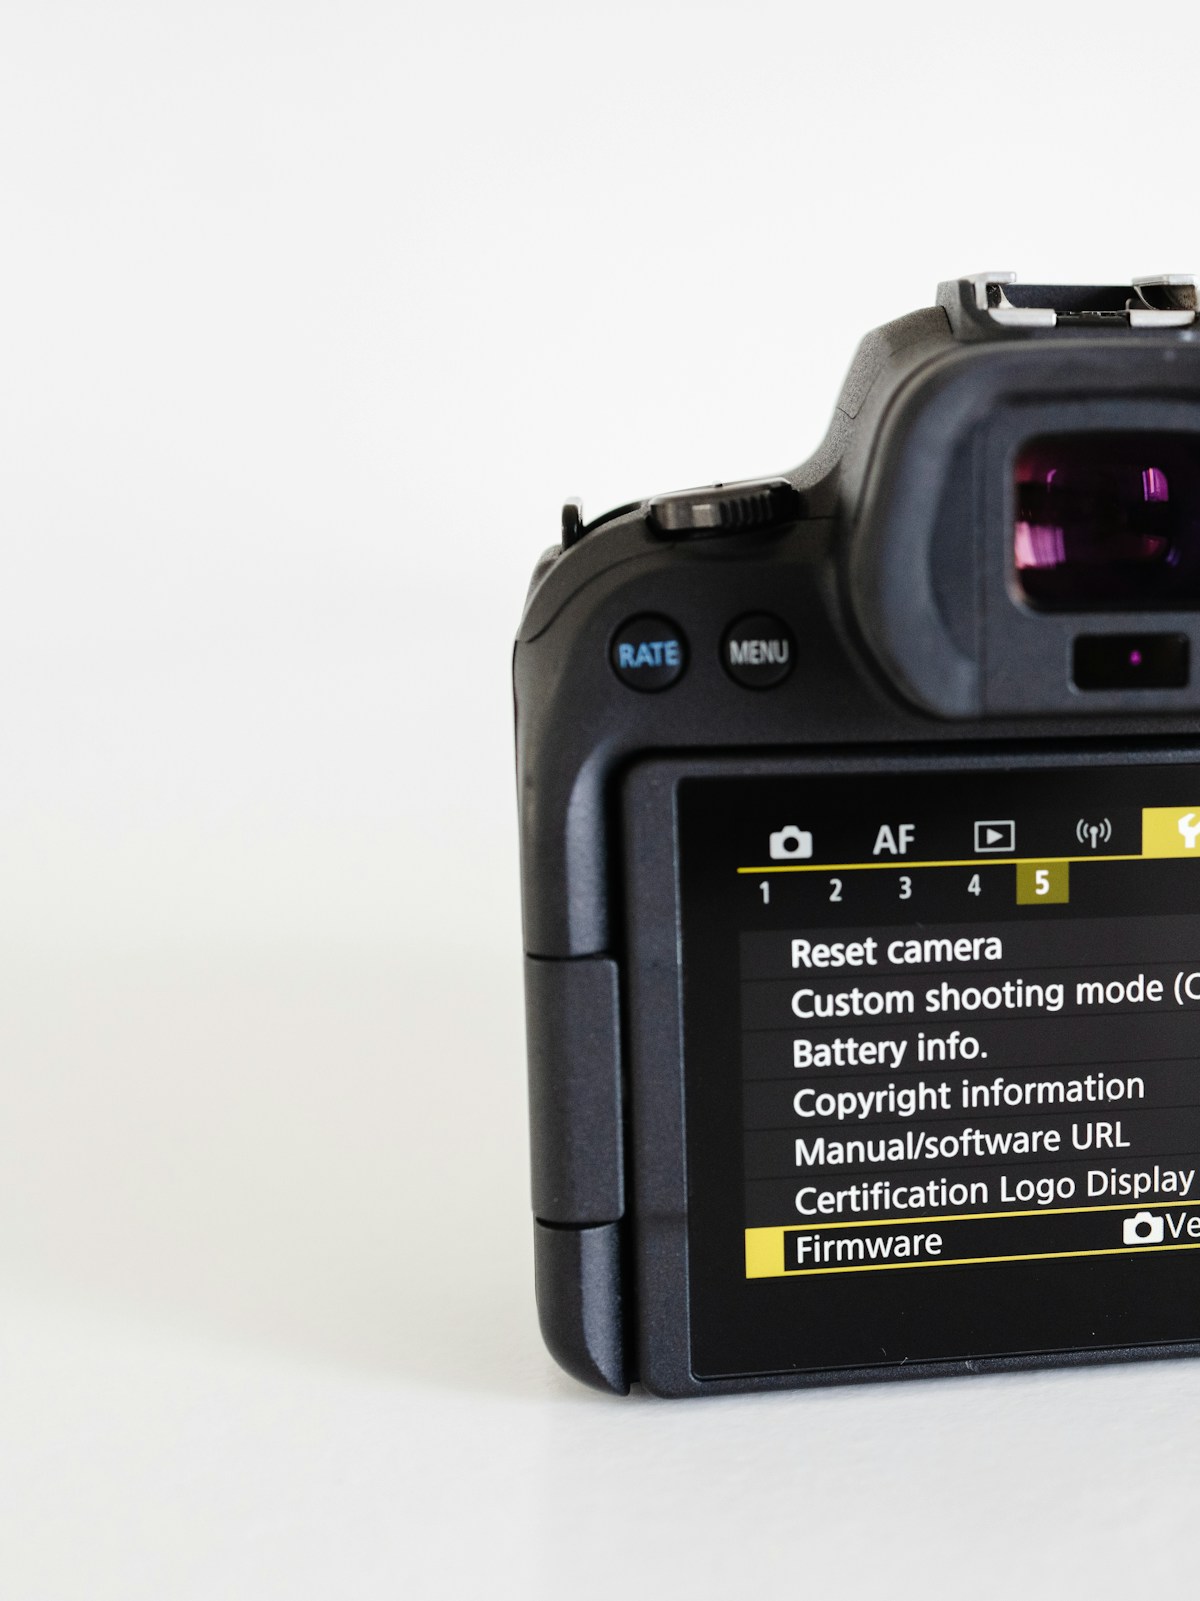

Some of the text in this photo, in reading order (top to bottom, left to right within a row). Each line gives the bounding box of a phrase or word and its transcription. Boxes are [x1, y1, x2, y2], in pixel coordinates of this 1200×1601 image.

[618, 640, 680, 667] RATE
[729, 640, 788, 665] MENU
[872, 823, 915, 856] AF
[759, 869, 1050, 904] 1 2 3 4 5
[791, 936, 1003, 969] Reset camera
[791, 987, 915, 1019] Custom
[925, 978, 1064, 1013] shooting
[1076, 973, 1164, 1005] mode
[793, 1030, 988, 1069] Battery info.
[793, 1072, 1145, 1119] Copyright information
[795, 1121, 1131, 1167] Manual/software URL
[795, 1165, 1196, 1215] Certification Logo Display
[796, 1233, 943, 1264] Firmware
